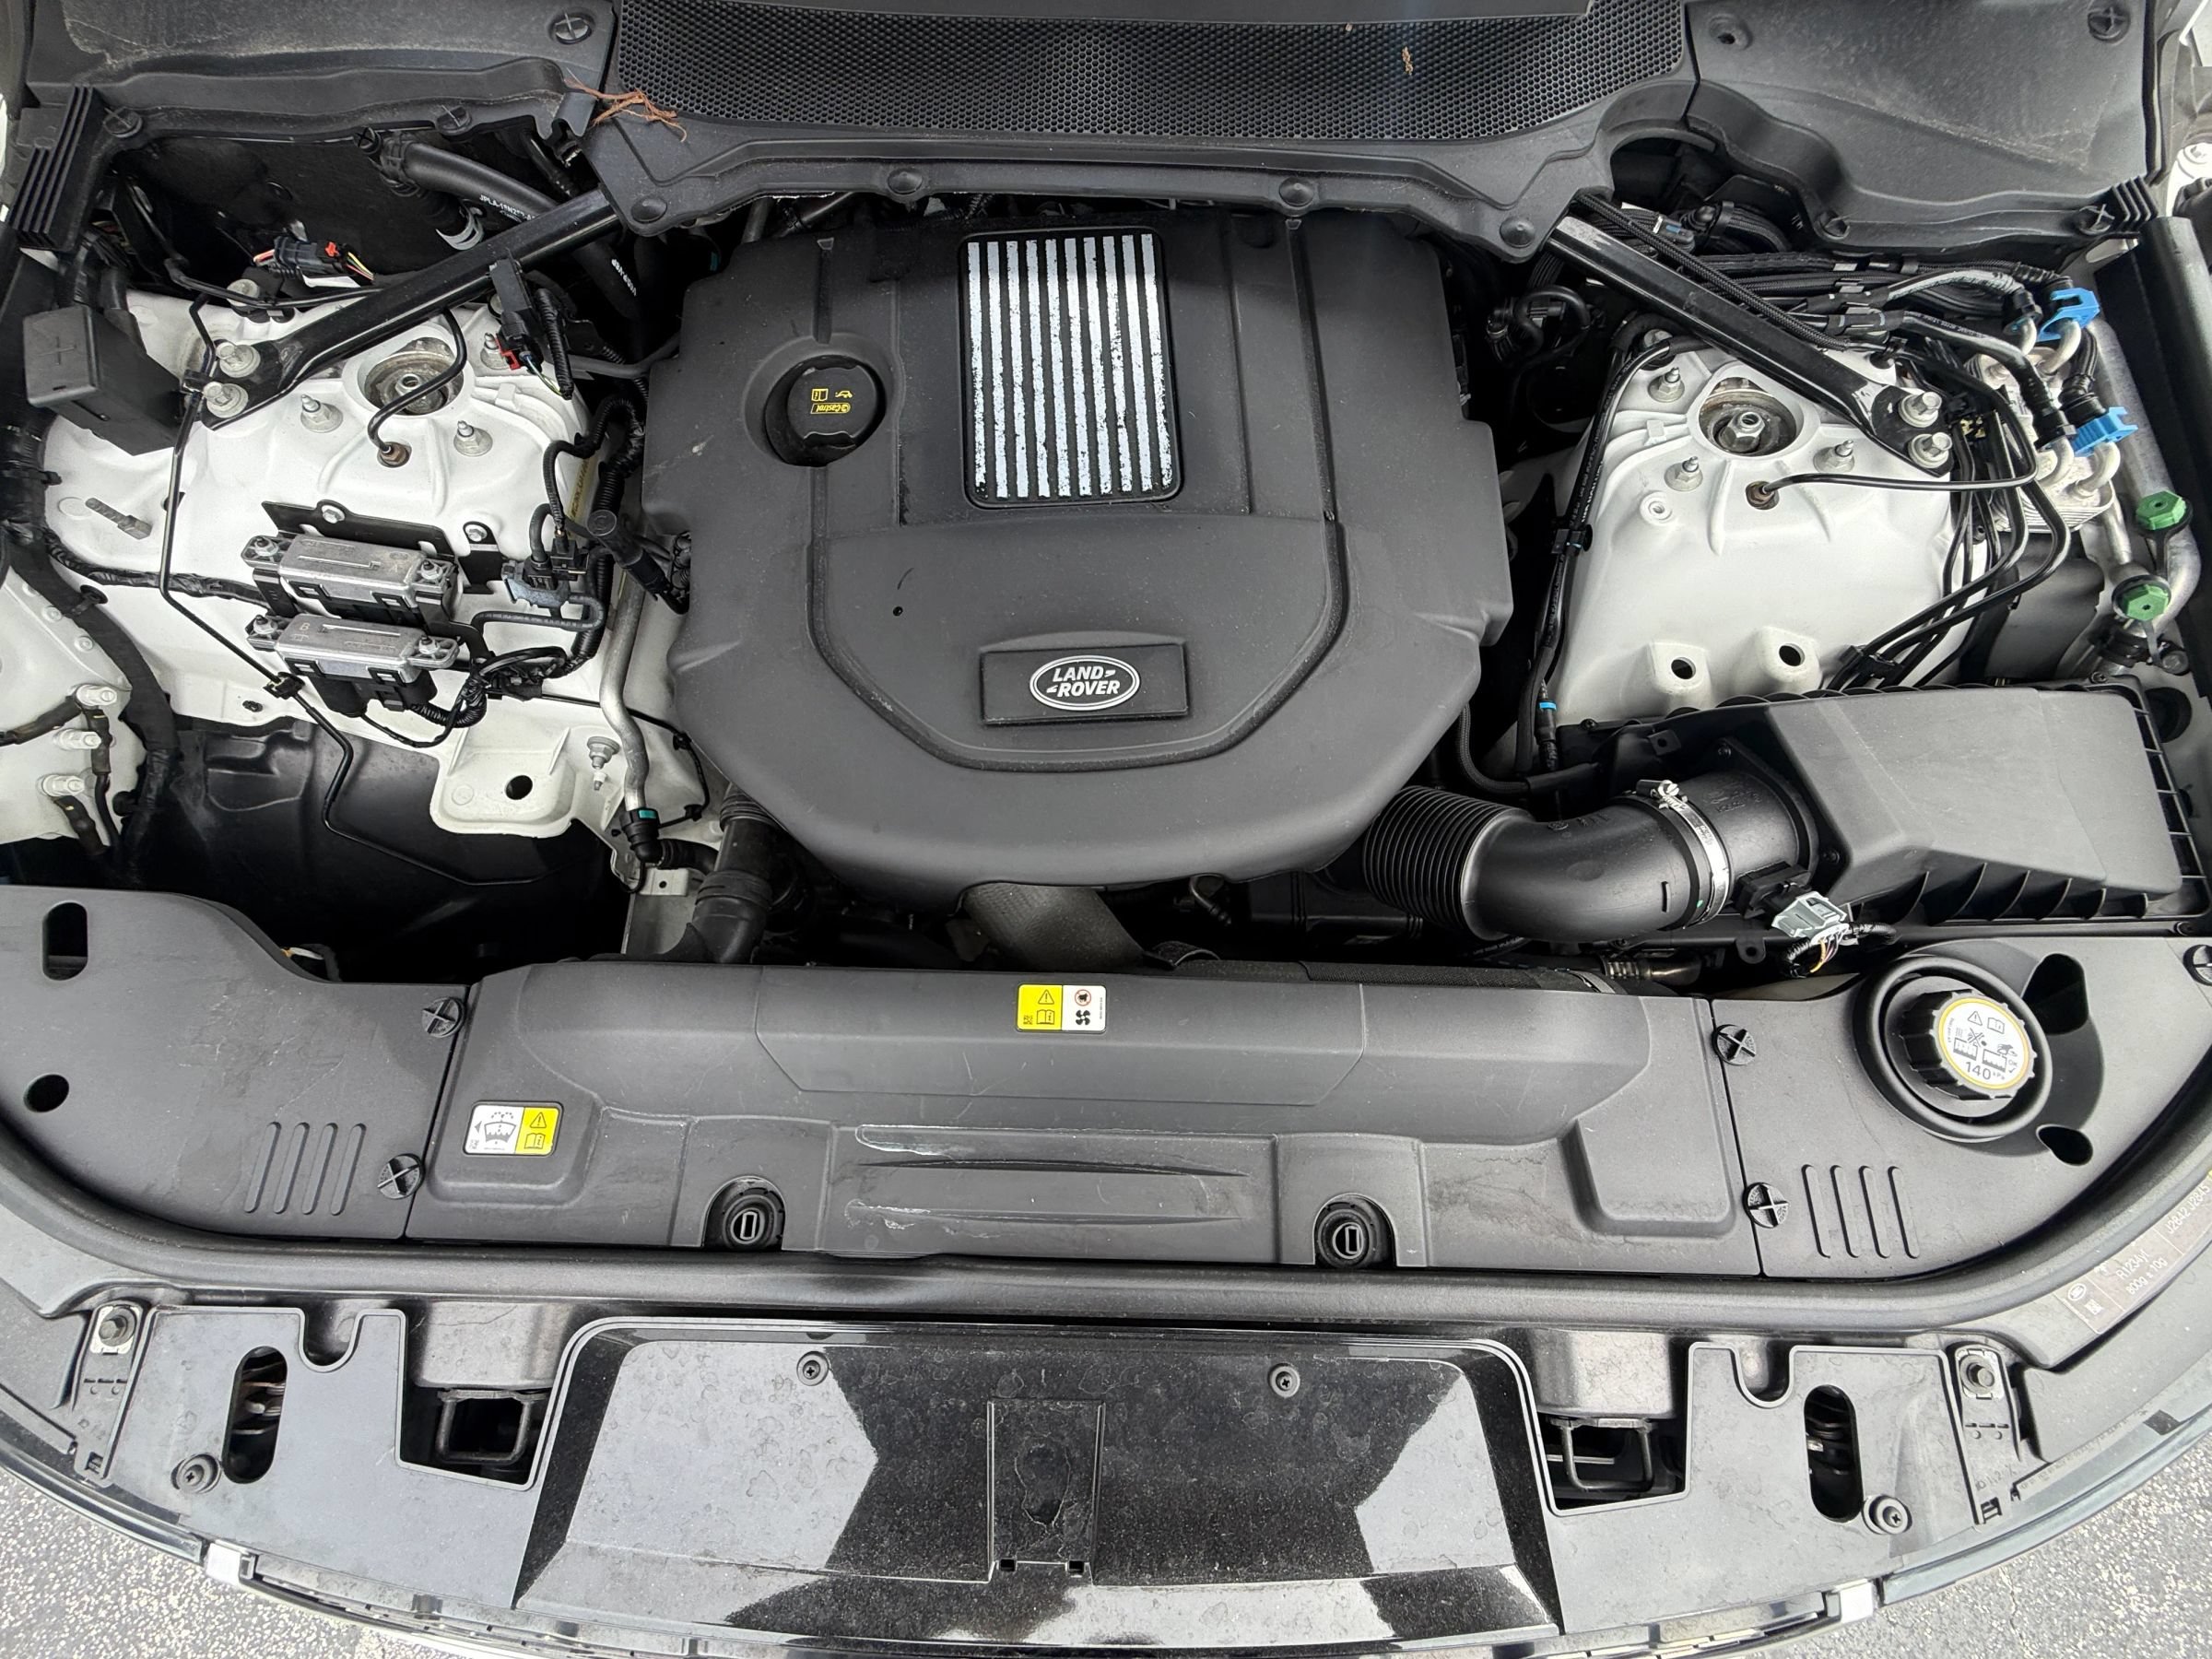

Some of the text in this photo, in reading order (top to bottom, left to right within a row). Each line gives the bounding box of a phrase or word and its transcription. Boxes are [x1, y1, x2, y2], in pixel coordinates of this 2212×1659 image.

[817, 405, 841, 413] Castrol
[1053, 665, 1104, 682] LAND
[1057, 680, 1121, 697] ROVER
[1966, 1061, 1991, 1080] 140
[2008, 1059, 2018, 1067] OK
[2164, 1184, 2211, 1235] J2842 J2845
[2125, 1276, 2148, 1295] 800g
[2150, 1257, 2168, 1273] 10g
